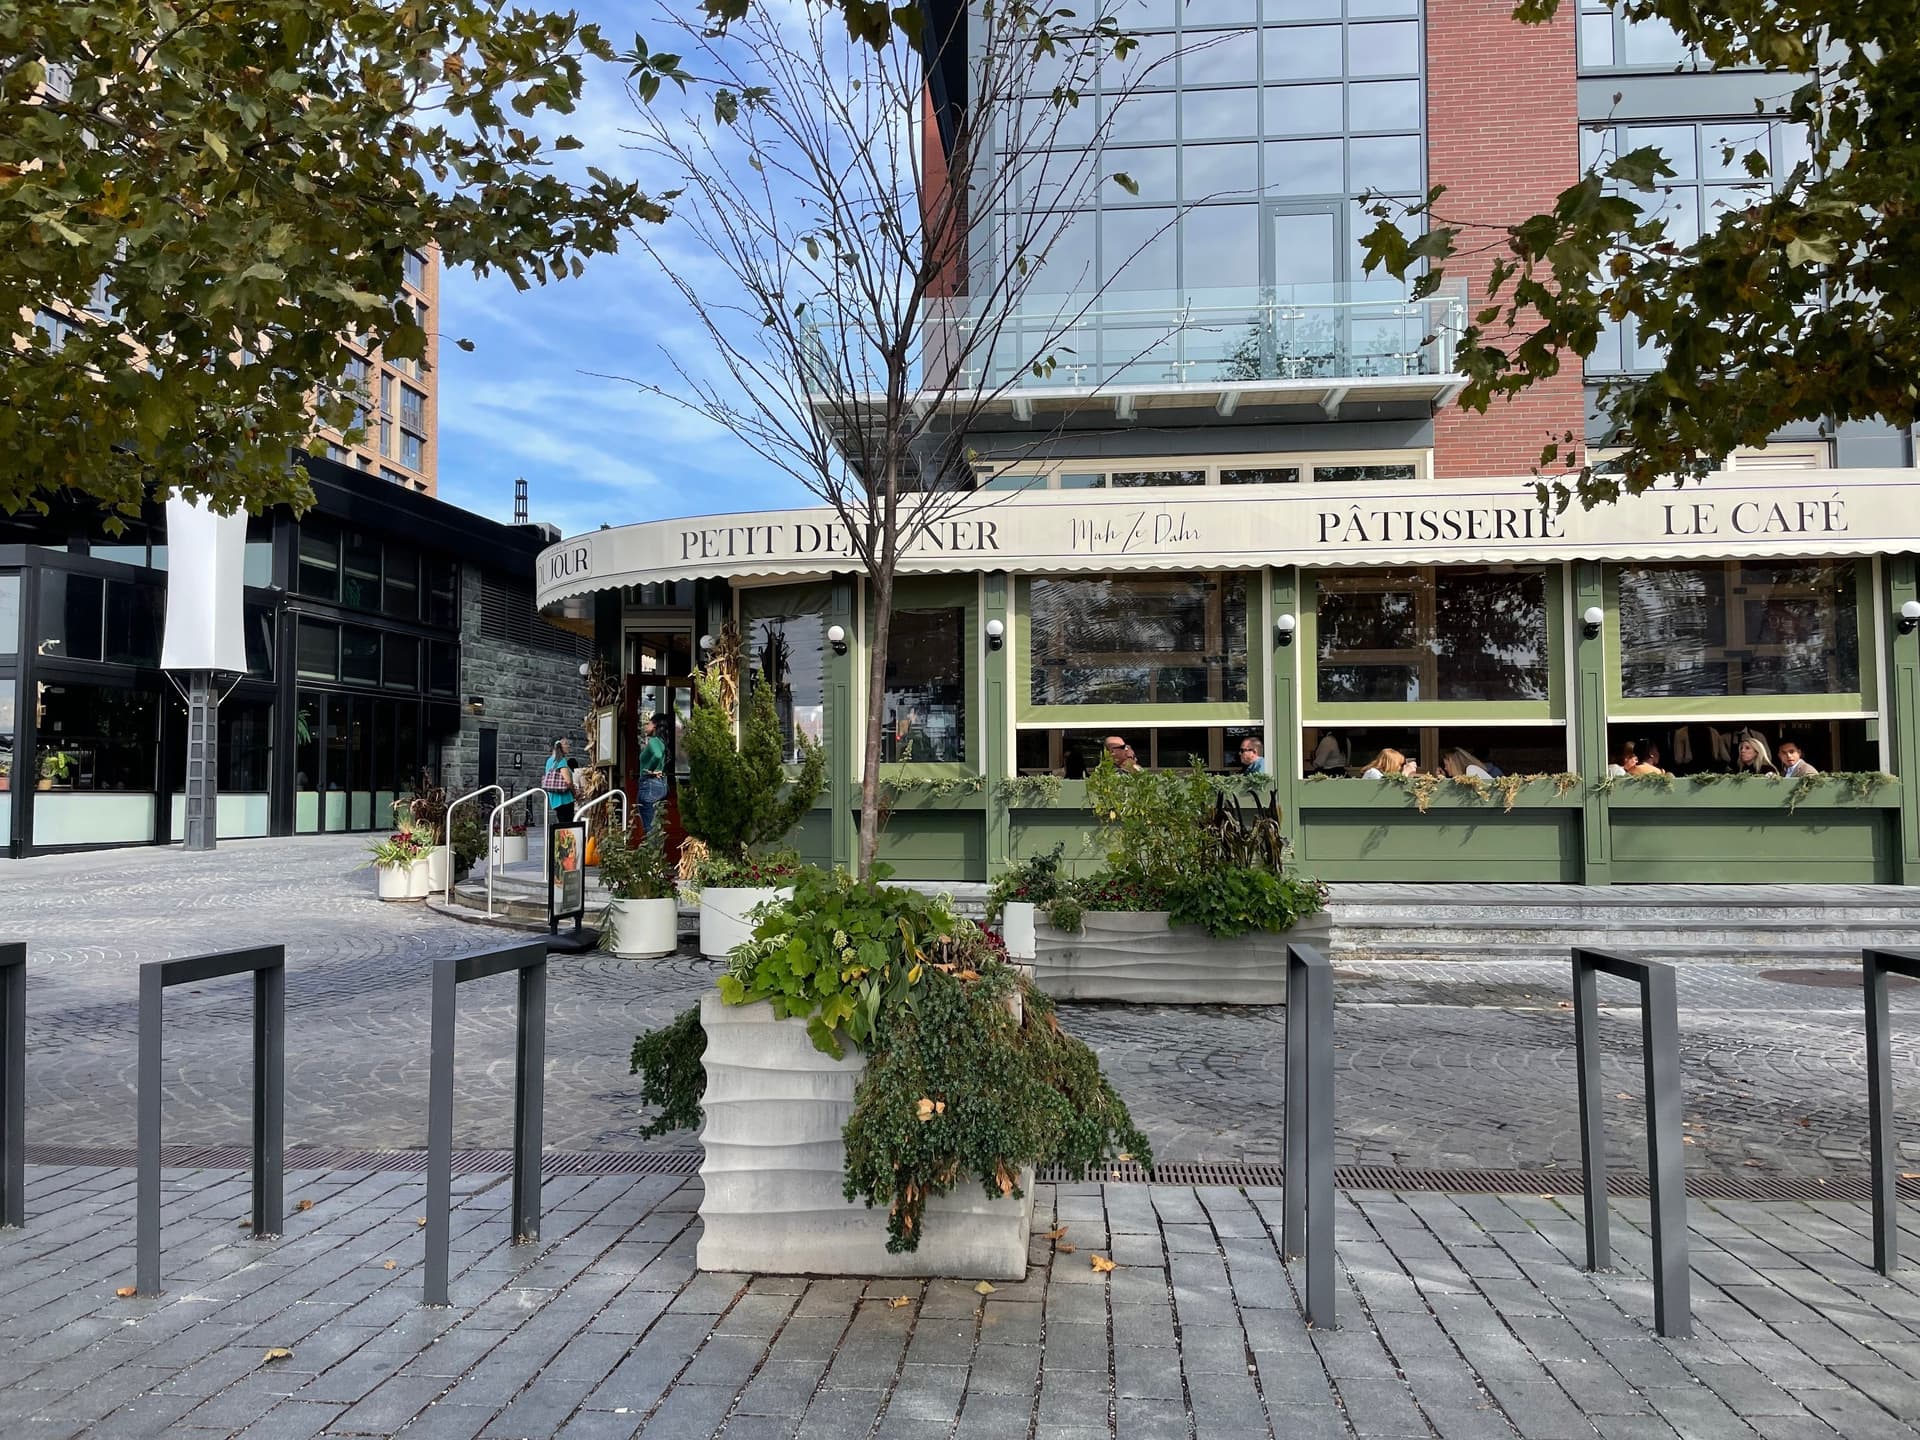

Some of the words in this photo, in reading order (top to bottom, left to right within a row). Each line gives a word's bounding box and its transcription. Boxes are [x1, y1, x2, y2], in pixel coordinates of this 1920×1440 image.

[1318, 504, 1565, 543] PÂTISSERIE
[1662, 504, 1718, 535] LE
[1731, 491, 1849, 534] CAFÉ
[680, 525, 783, 560] PETIT
[550, 548, 588, 581] JOUR
